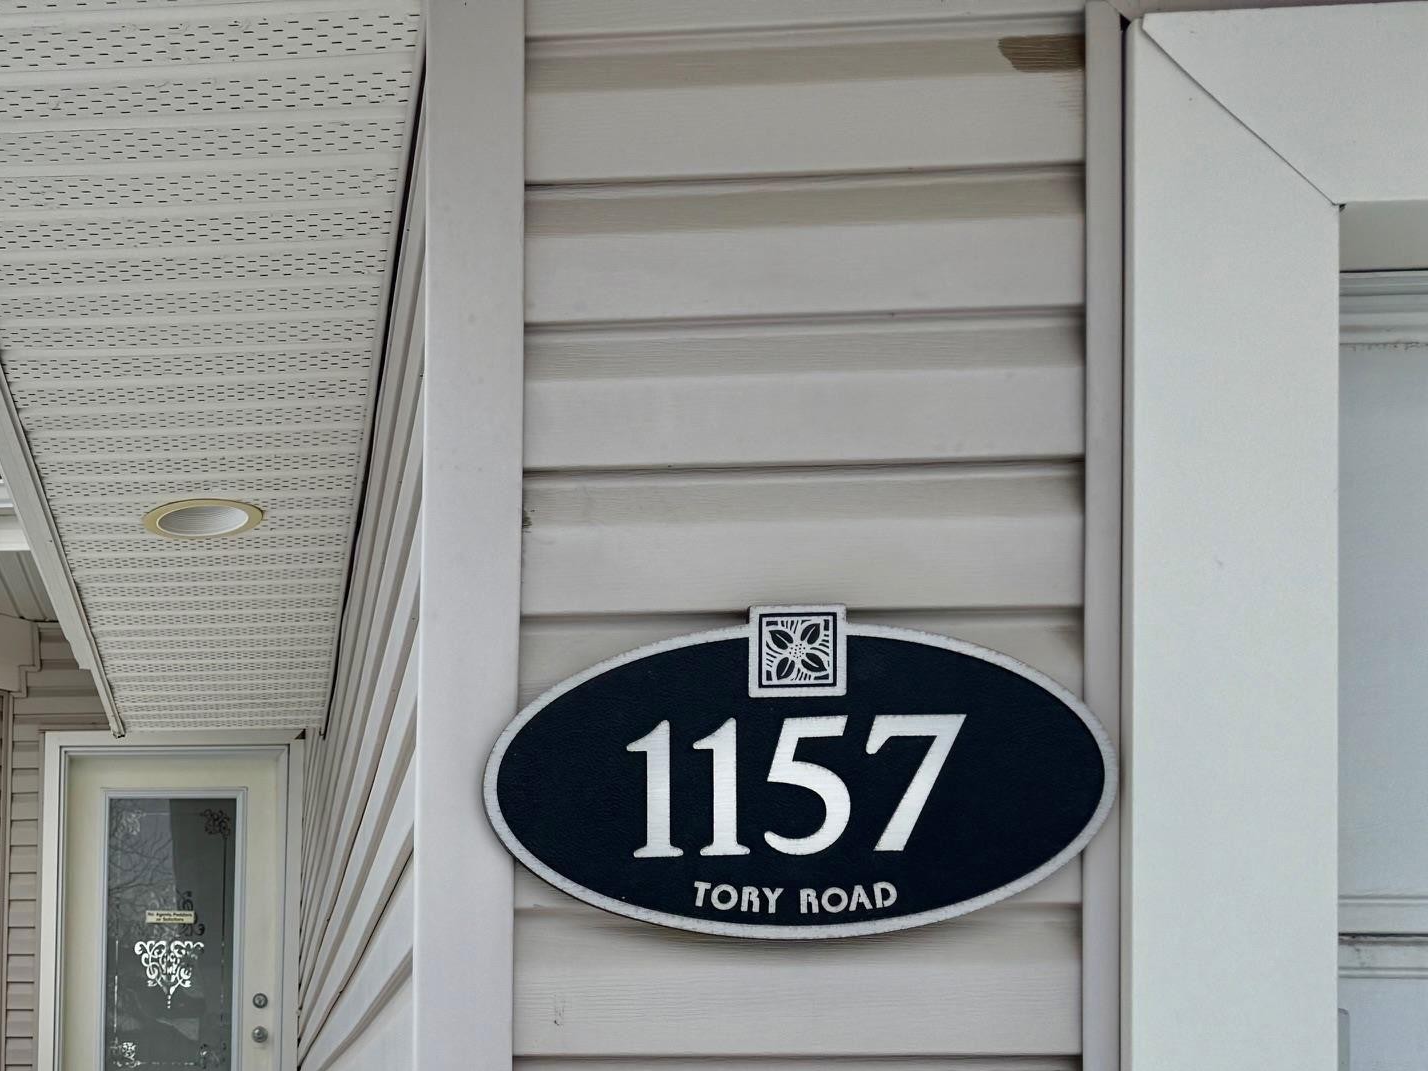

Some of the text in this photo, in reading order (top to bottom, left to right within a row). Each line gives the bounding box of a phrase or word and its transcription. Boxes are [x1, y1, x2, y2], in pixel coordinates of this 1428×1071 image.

[626, 714, 967, 858] 1157
[694, 881, 898, 914] TORY ROAD
